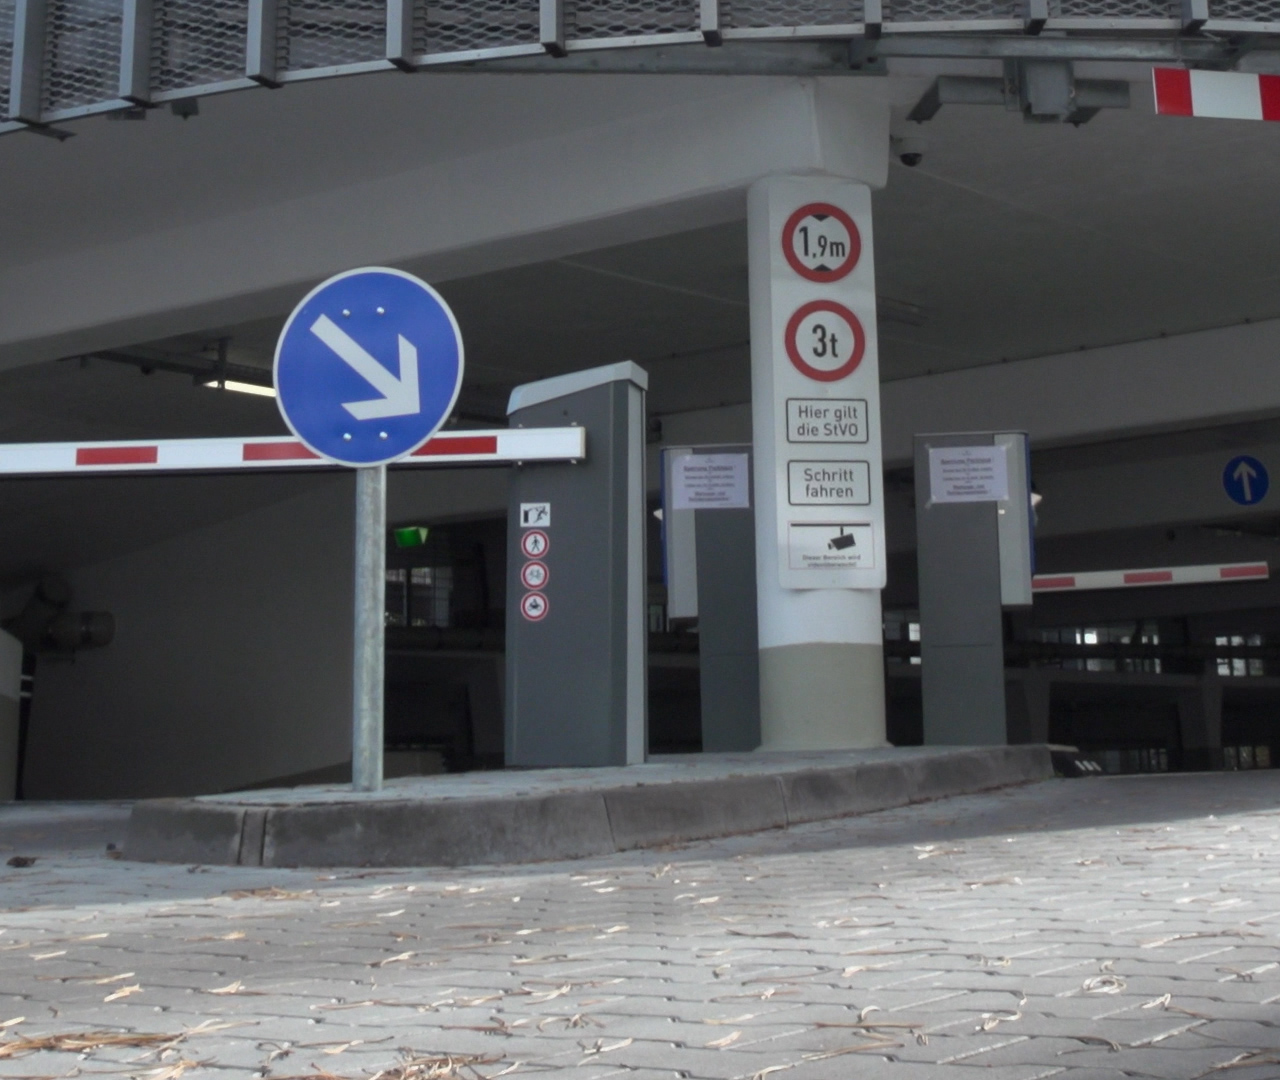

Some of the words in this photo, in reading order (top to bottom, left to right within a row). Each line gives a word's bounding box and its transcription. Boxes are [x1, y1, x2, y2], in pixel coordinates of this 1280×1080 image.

[798, 405, 829, 419] Hier
[834, 405, 858, 422] gilt
[797, 423, 819, 436] die
[823, 423, 858, 436] StVO
[803, 468, 854, 482] Schritt
[805, 484, 854, 498] fahren
